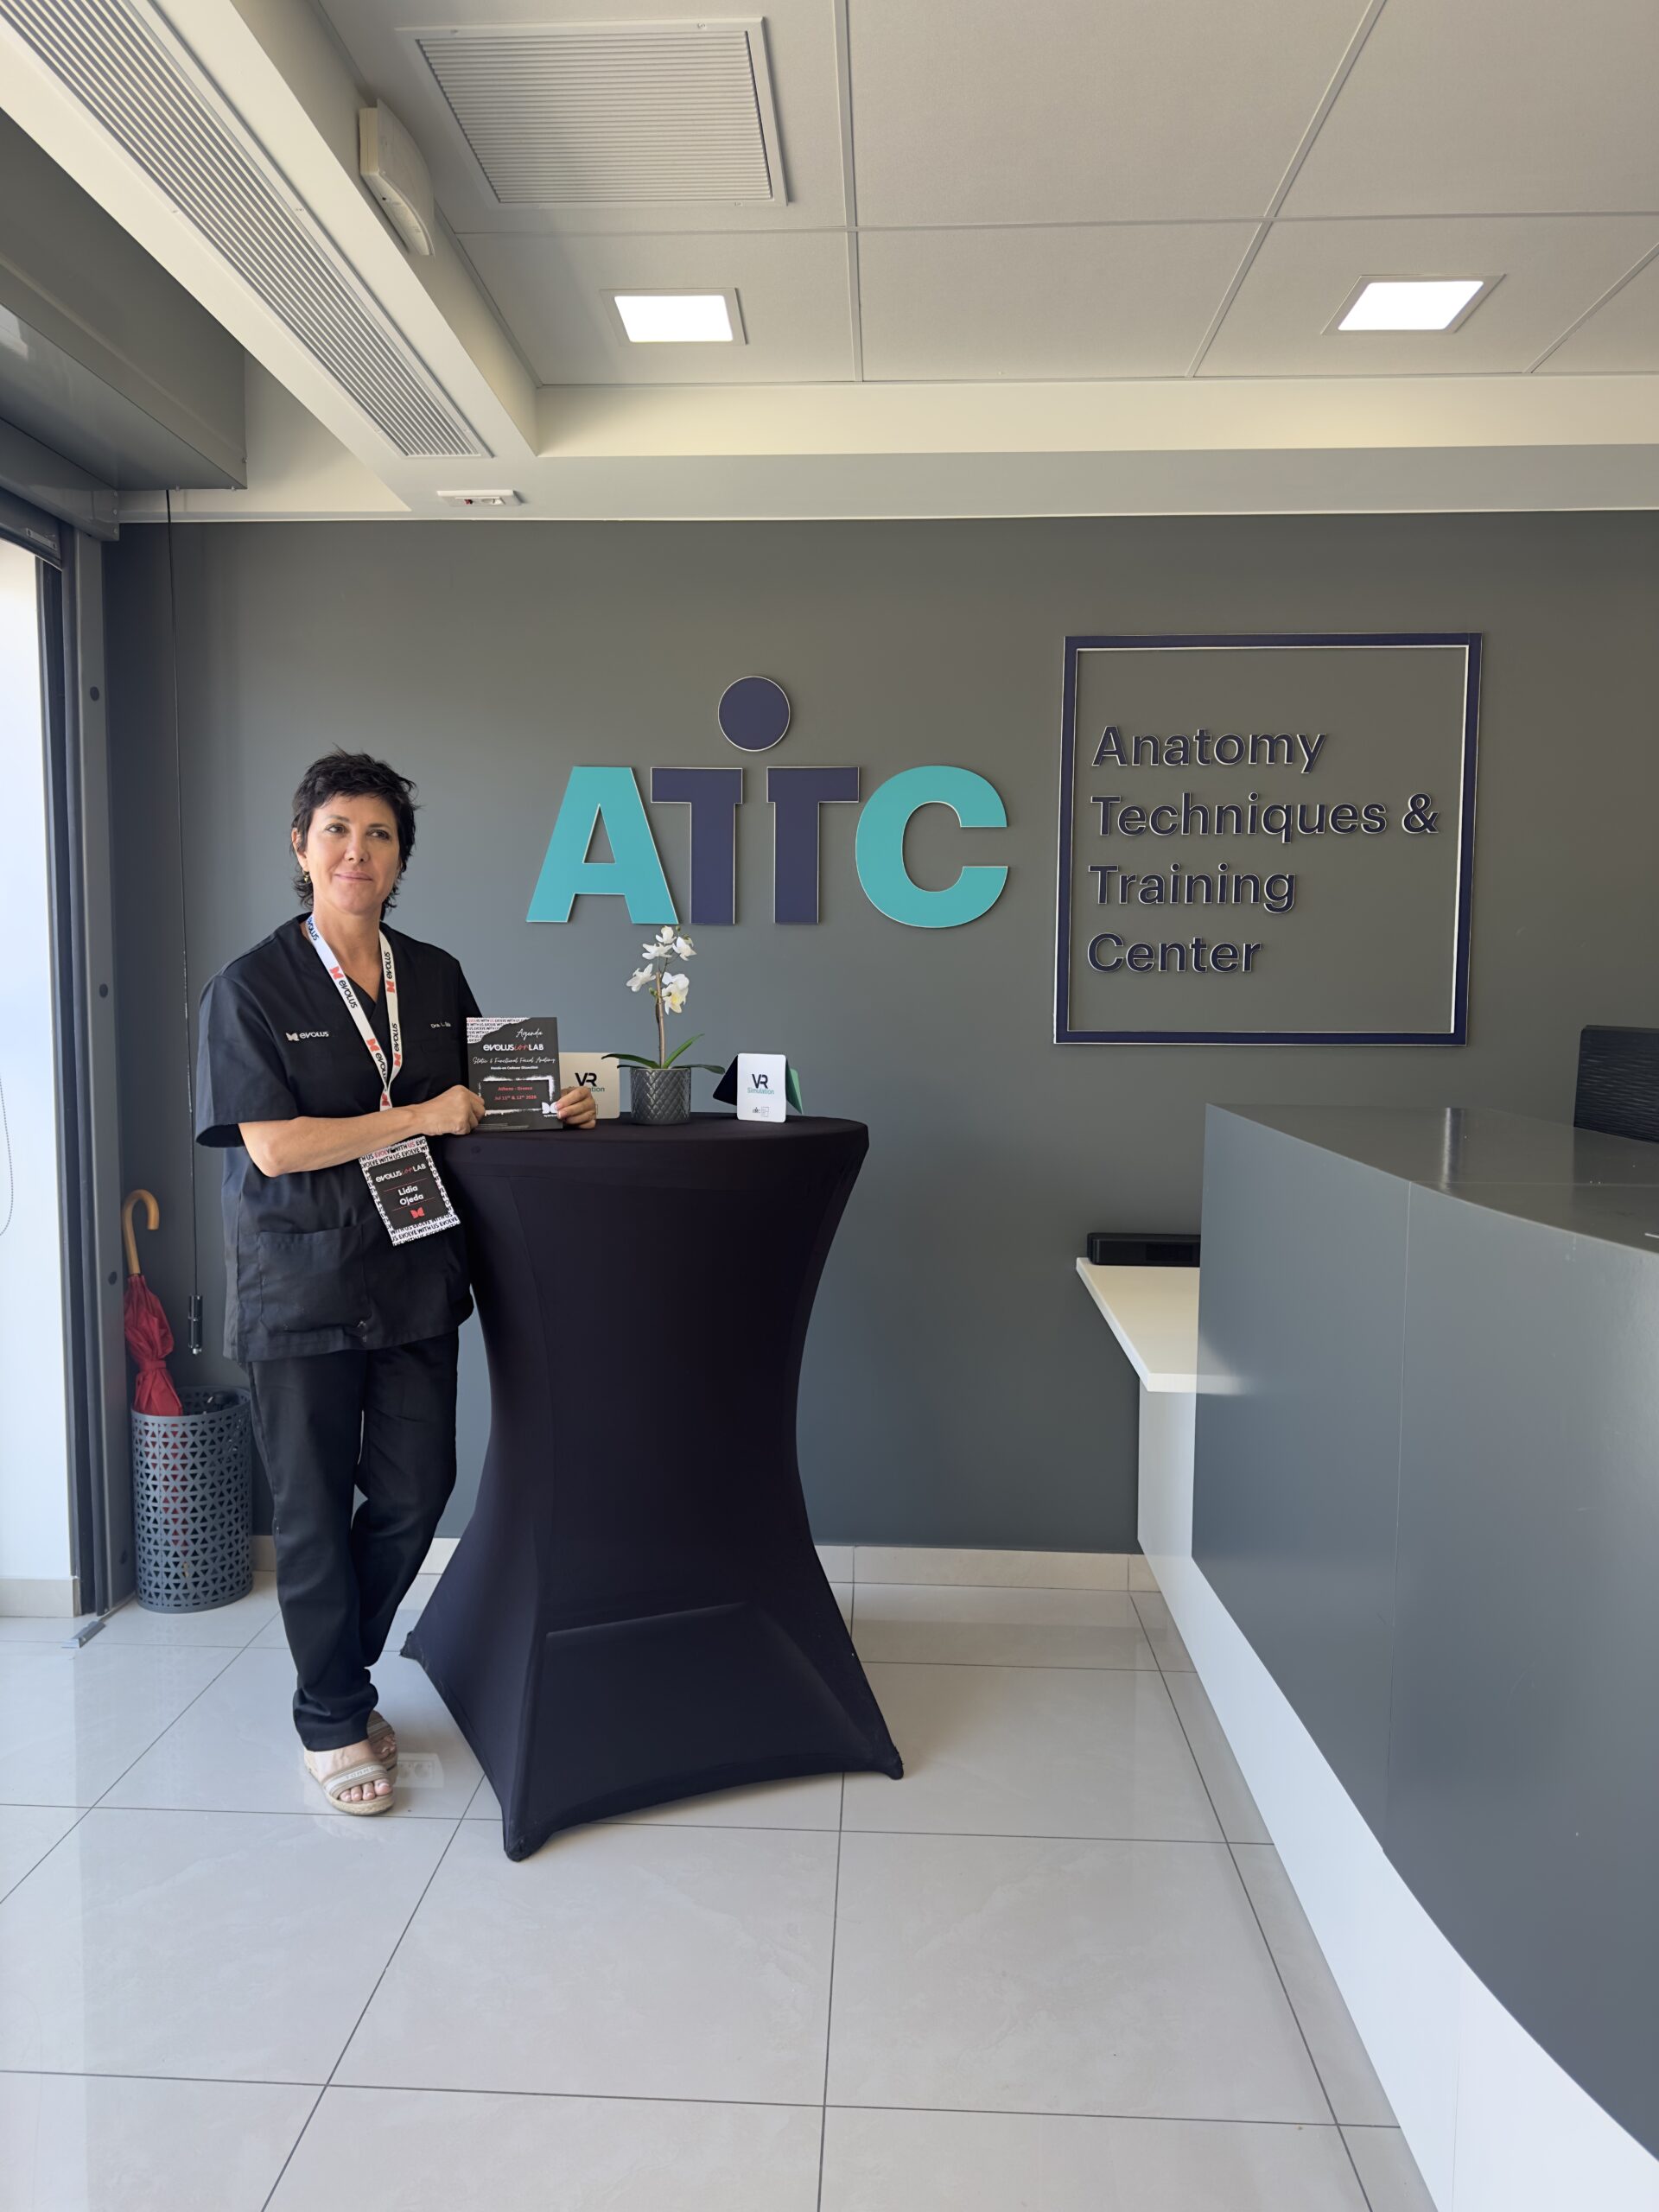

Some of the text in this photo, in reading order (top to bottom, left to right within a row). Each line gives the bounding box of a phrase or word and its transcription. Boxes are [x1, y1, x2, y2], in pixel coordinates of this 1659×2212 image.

[1091, 726, 1327, 774] Anatomy
[1090, 792, 1439, 844] Techniques &
[1089, 863, 1297, 913] Training
[1088, 932, 1262, 973] Center
[516, 1028, 543, 1041] Agenda
[575, 1072, 597, 1087] VR
[752, 1073, 769, 1089] VR
[397, 1185, 418, 1196] Lidia
[399, 1193, 424, 1205] Ojeda
